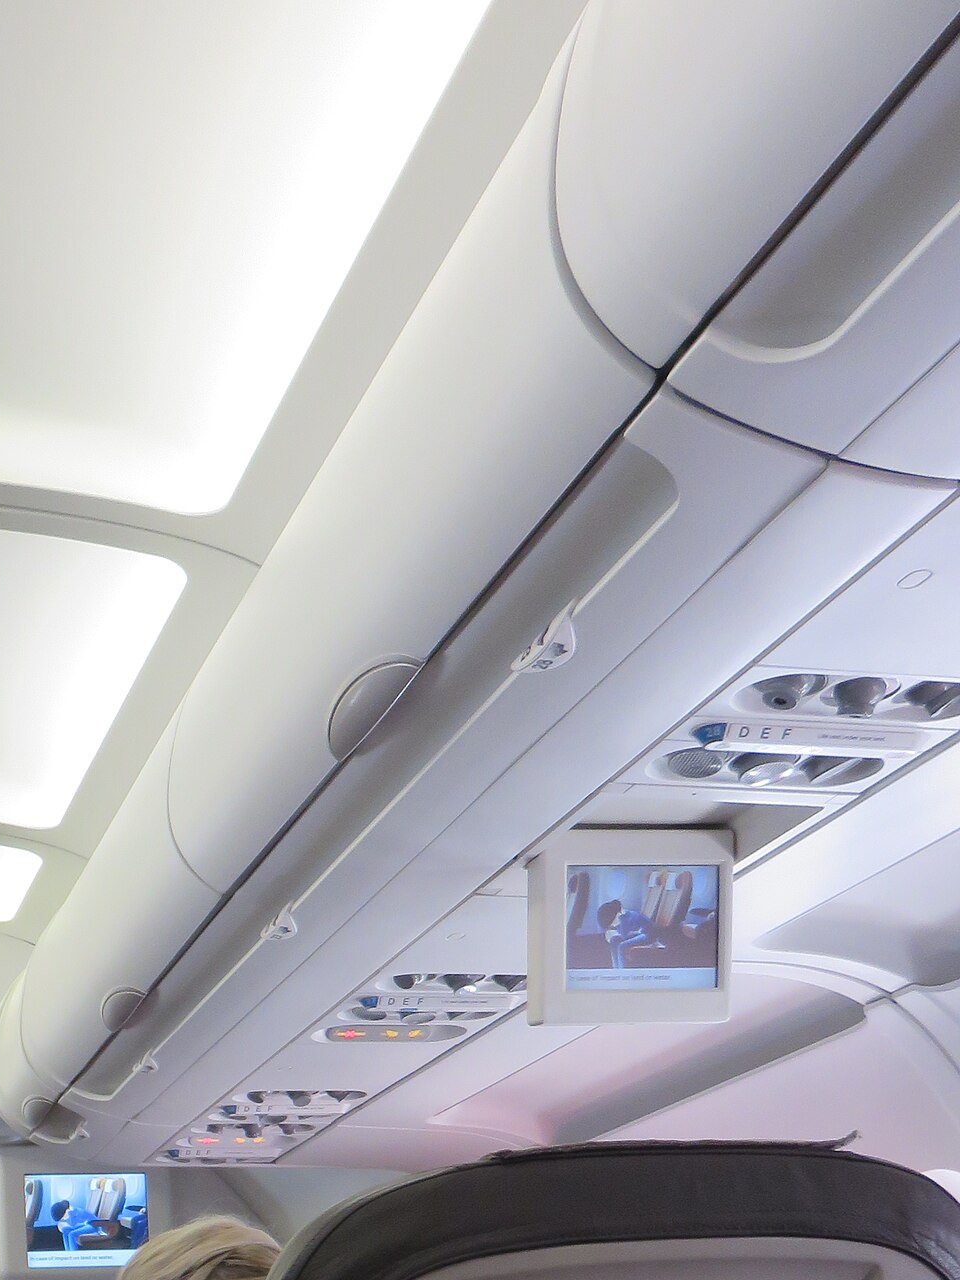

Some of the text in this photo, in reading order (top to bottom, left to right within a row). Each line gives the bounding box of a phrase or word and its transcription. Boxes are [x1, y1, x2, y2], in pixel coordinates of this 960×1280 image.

[739, 726, 750, 738] D
[760, 727, 772, 739] E
[782, 728, 792, 740] F
[387, 997, 425, 1006] D E F
